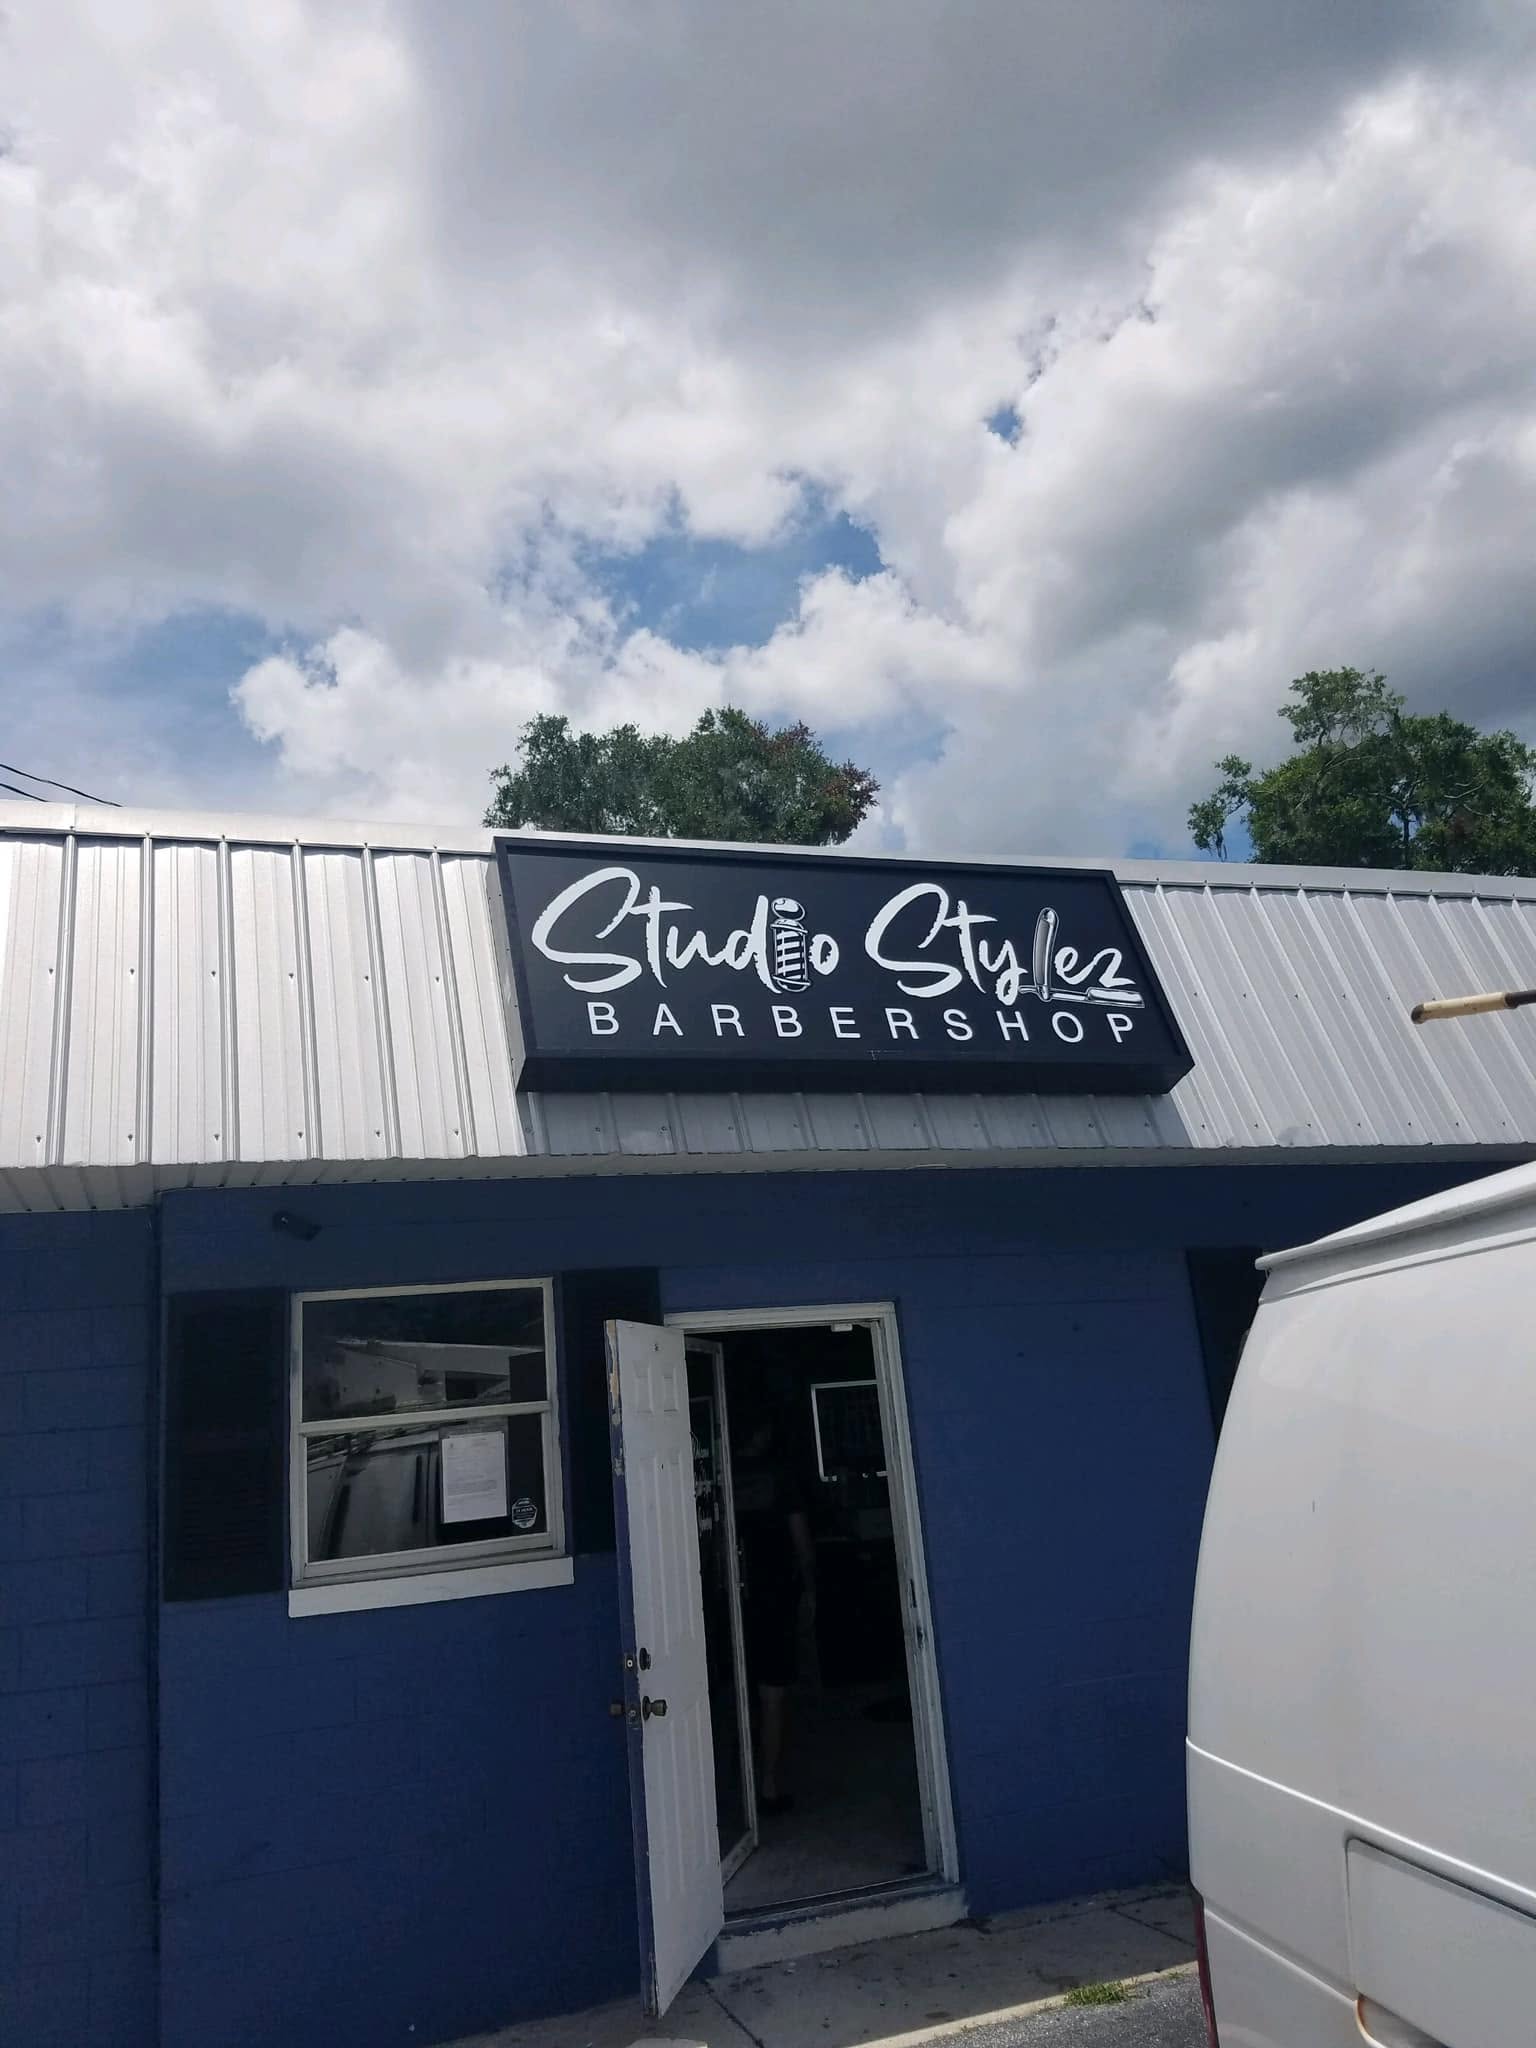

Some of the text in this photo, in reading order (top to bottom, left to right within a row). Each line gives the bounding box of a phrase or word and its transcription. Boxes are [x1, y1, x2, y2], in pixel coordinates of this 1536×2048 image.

[531, 866, 1145, 1009] Studio Stylez
[588, 1002, 1134, 1043] BARBERSHOP
